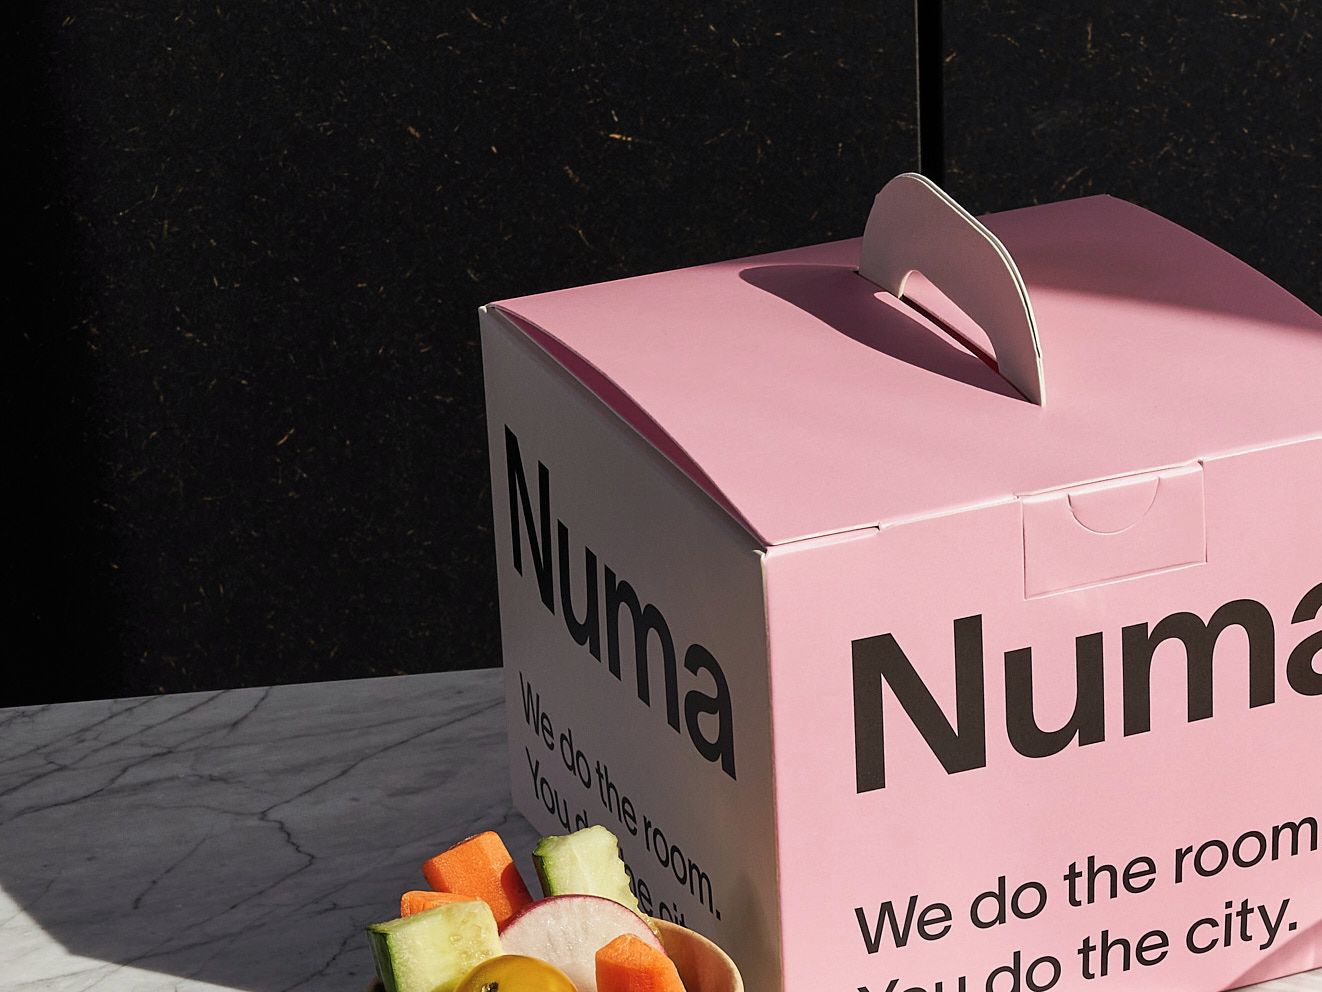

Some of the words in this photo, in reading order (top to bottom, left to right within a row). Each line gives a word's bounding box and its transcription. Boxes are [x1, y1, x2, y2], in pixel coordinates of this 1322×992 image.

[505, 424, 736, 781] Numa
[518, 671, 555, 752] We
[559, 726, 592, 789] do
[595, 760, 638, 836] the
[643, 815, 722, 921] room.
[526, 747, 571, 834] You
[854, 895, 952, 955] We
[969, 876, 1047, 929] do
[1063, 855, 1157, 907] the
[1077, 929, 1170, 981] the
[1186, 897, 1299, 954] city.
